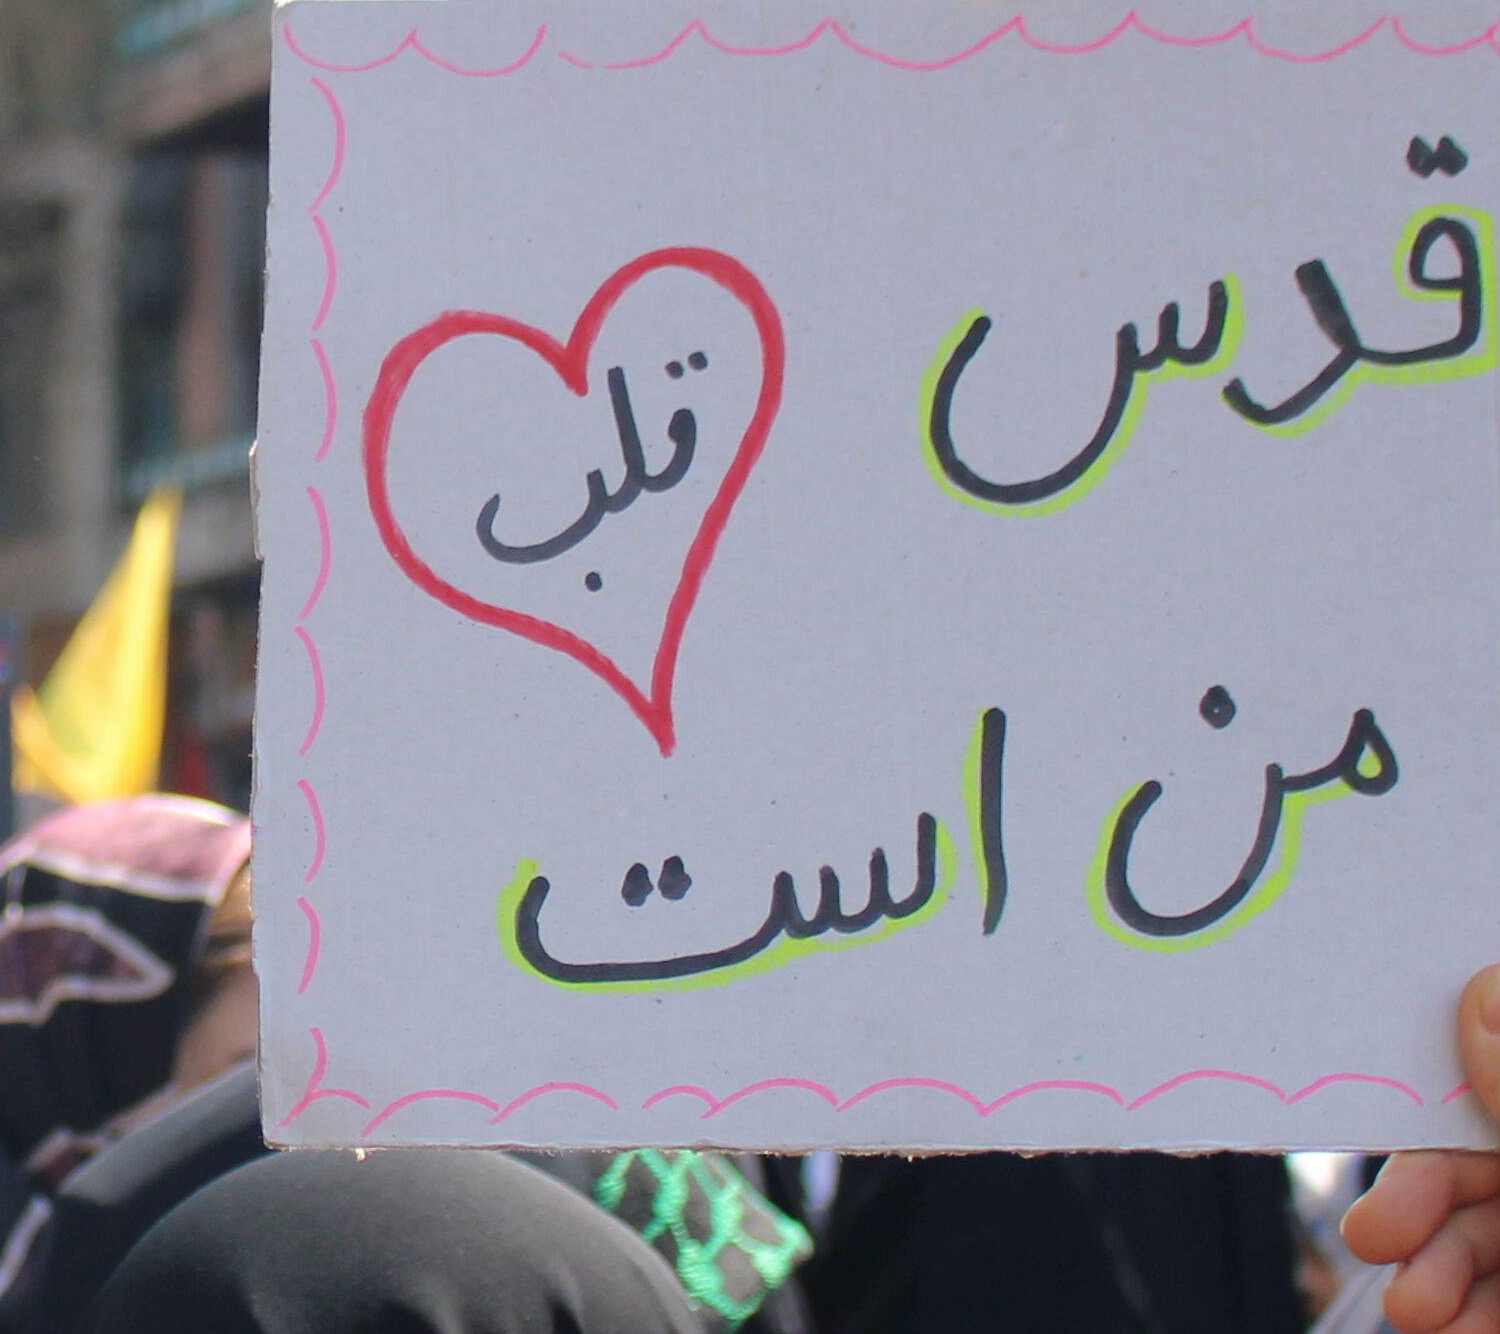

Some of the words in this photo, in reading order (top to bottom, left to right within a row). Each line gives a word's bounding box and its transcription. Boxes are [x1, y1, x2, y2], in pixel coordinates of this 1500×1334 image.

[929, 135, 1484, 505] قدس
[476, 350, 709, 592] قلب
[513, 706, 1008, 985] است
[1104, 684, 1400, 938] من
